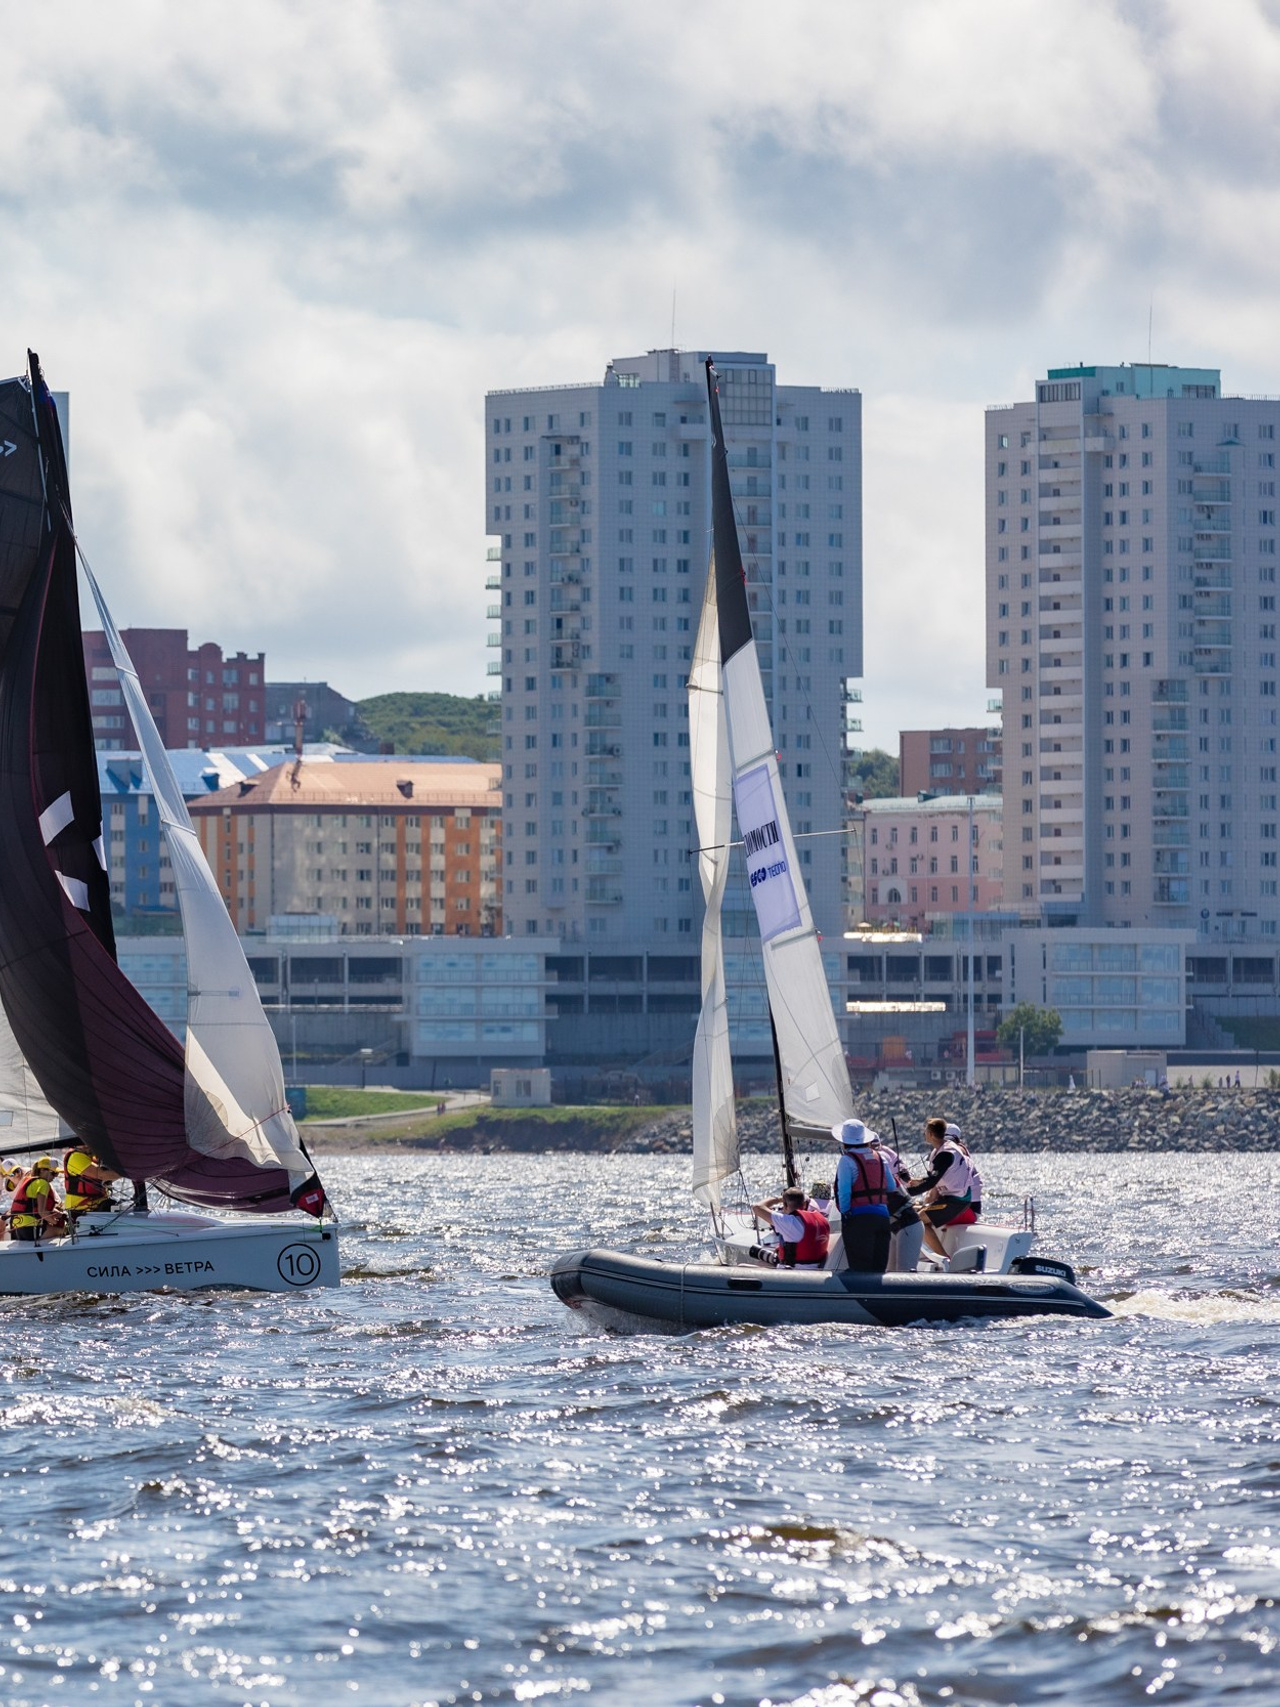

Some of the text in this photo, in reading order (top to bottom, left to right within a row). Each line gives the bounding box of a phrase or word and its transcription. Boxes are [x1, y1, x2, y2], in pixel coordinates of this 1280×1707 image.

[750, 866, 767, 888] ESCO
[86, 1260, 215, 1278] СИЛА ВЕТРА
[284, 1253, 315, 1277] 10
[1035, 1264, 1067, 1277] SUZUKI
